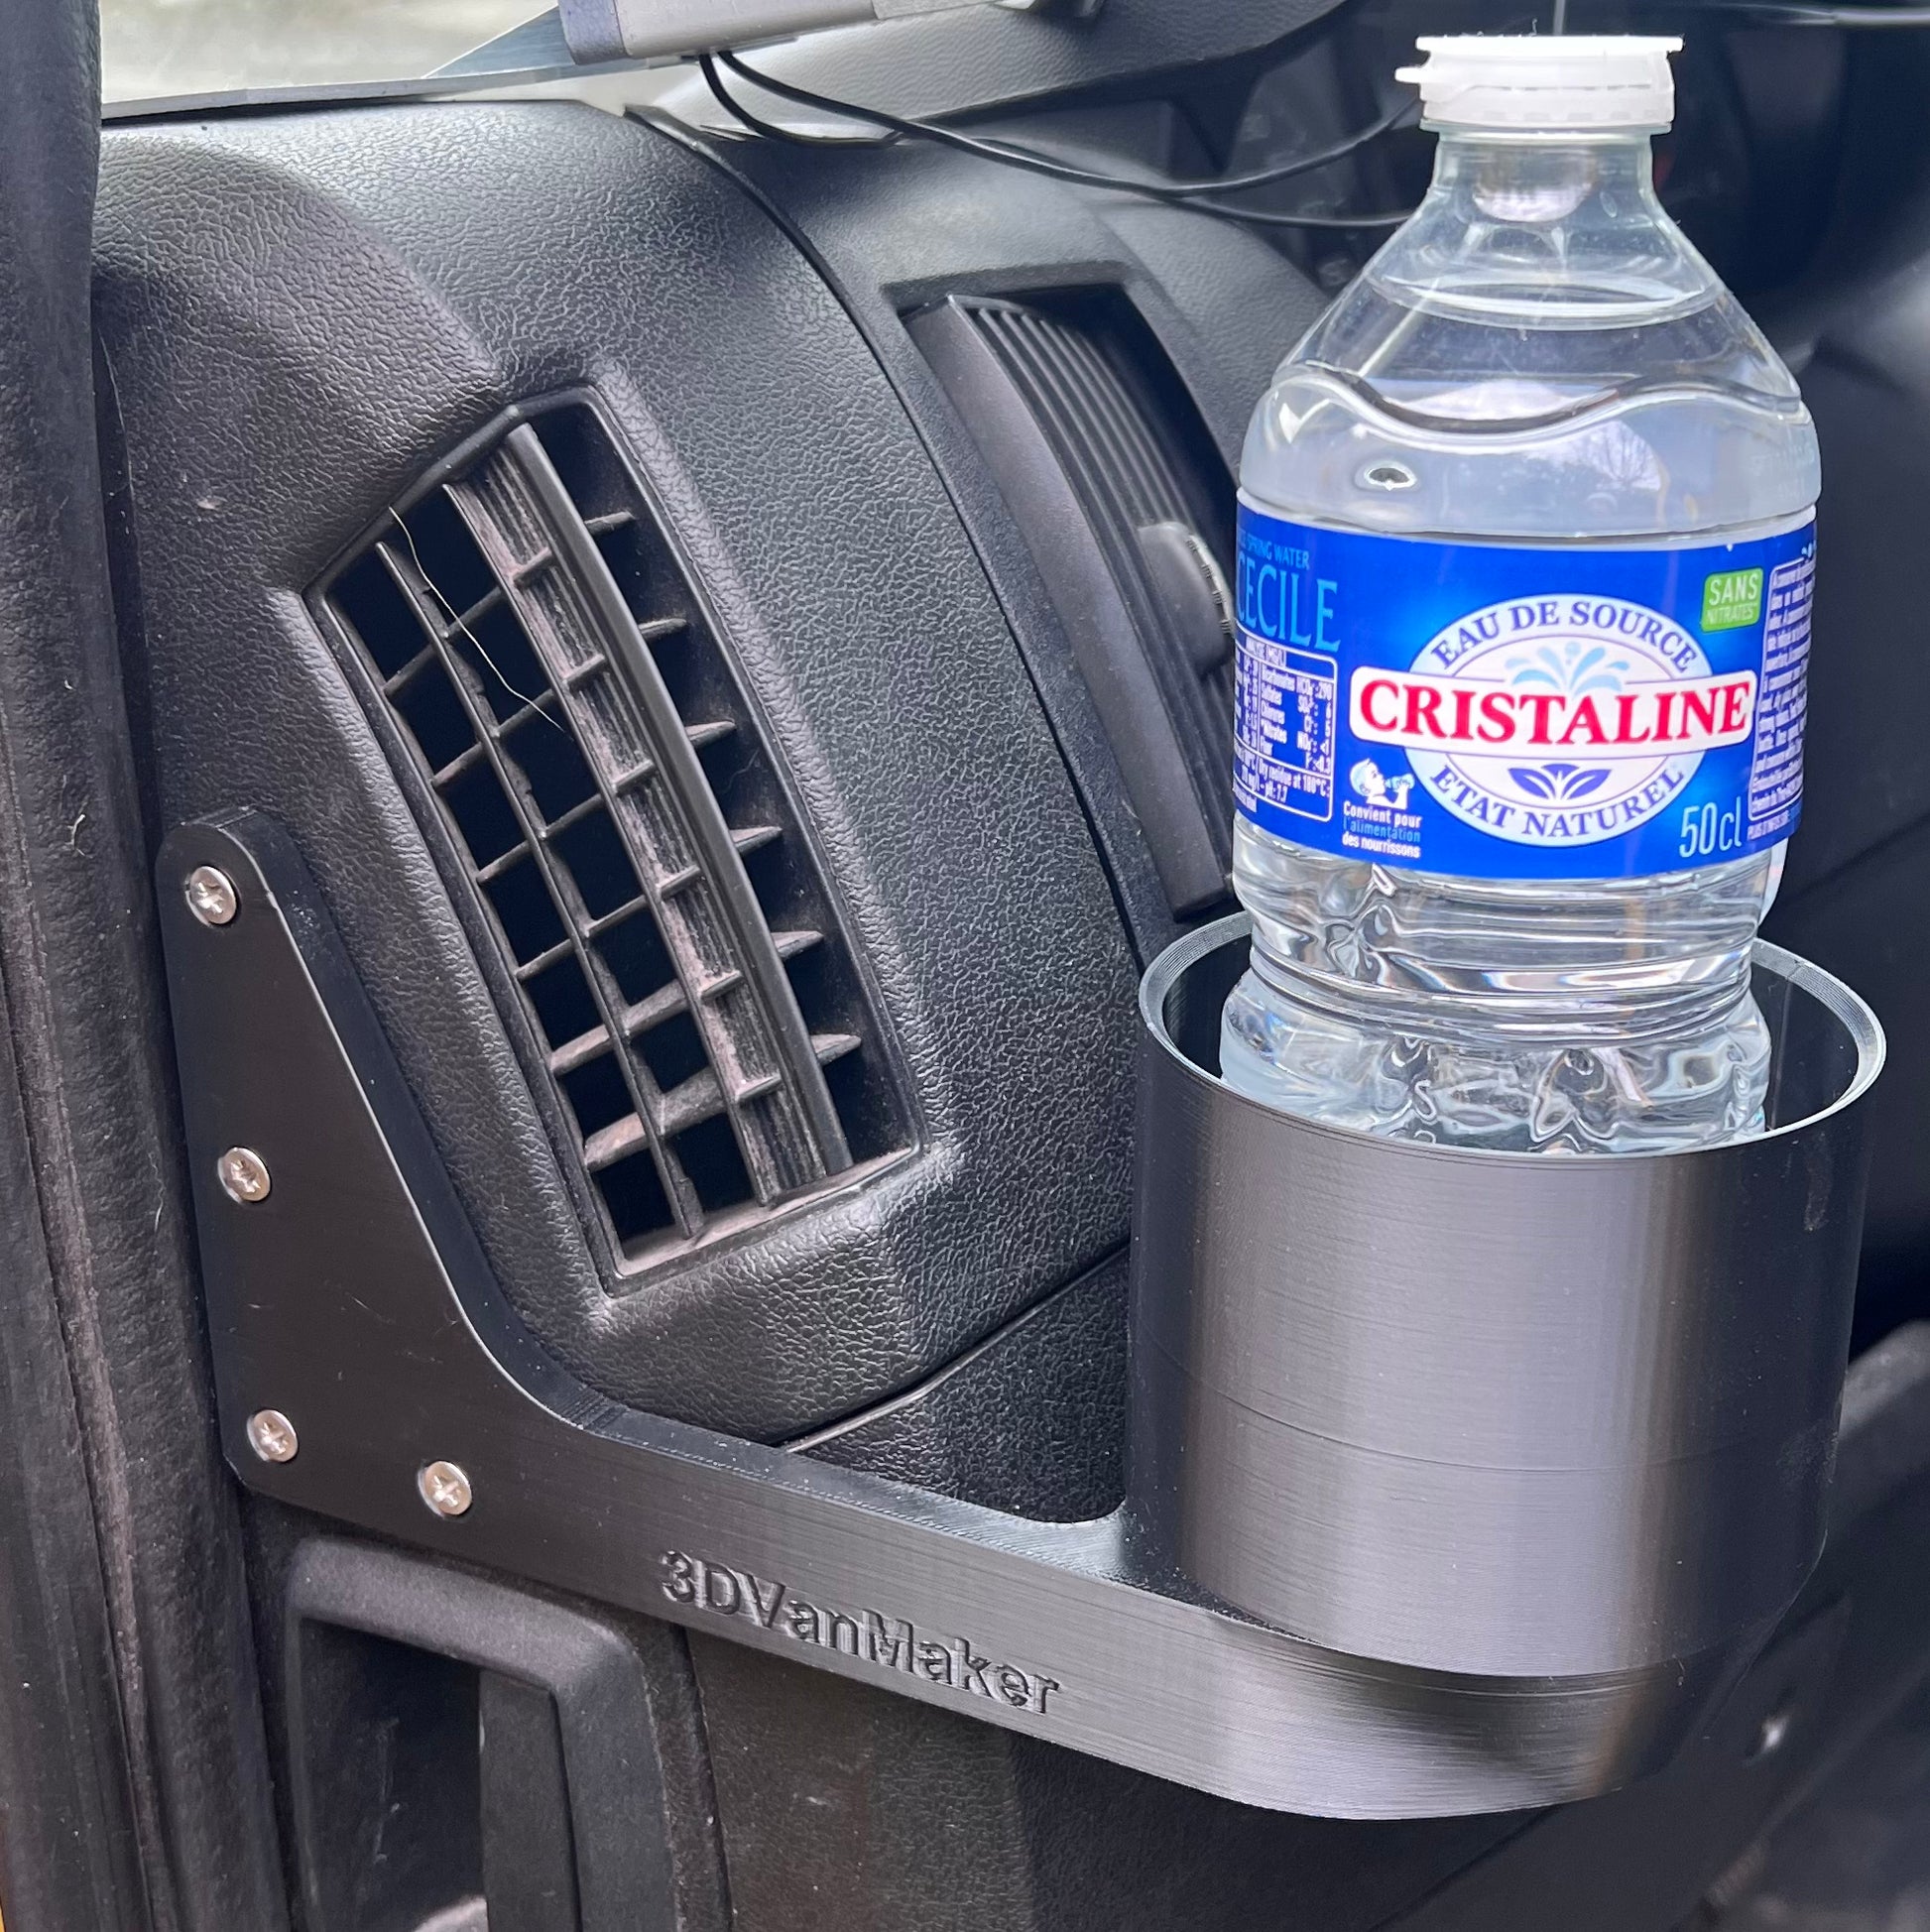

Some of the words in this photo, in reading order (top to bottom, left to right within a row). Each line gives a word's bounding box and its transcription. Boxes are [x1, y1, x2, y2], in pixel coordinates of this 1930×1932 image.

[1273, 543, 1310, 570] WATER
[1709, 573, 1759, 606] SANS
[1431, 617, 1502, 669] EAU
[1509, 601, 1561, 633] DE
[1569, 601, 1698, 674] SOURCE
[1360, 679, 1751, 746] CRISTALINE
[1343, 800, 1391, 824] Convient
[1393, 813, 1423, 829] pour
[1429, 765, 1516, 838] ETAT
[1522, 769, 1684, 838] NATUREL
[1342, 830, 1360, 848] des
[1361, 836, 1421, 859] nourrissons
[1343, 815, 1421, 843] l'alimentation
[1679, 795, 1743, 859] 50cl
[658, 1548, 1061, 1714] 3DVanMaker
